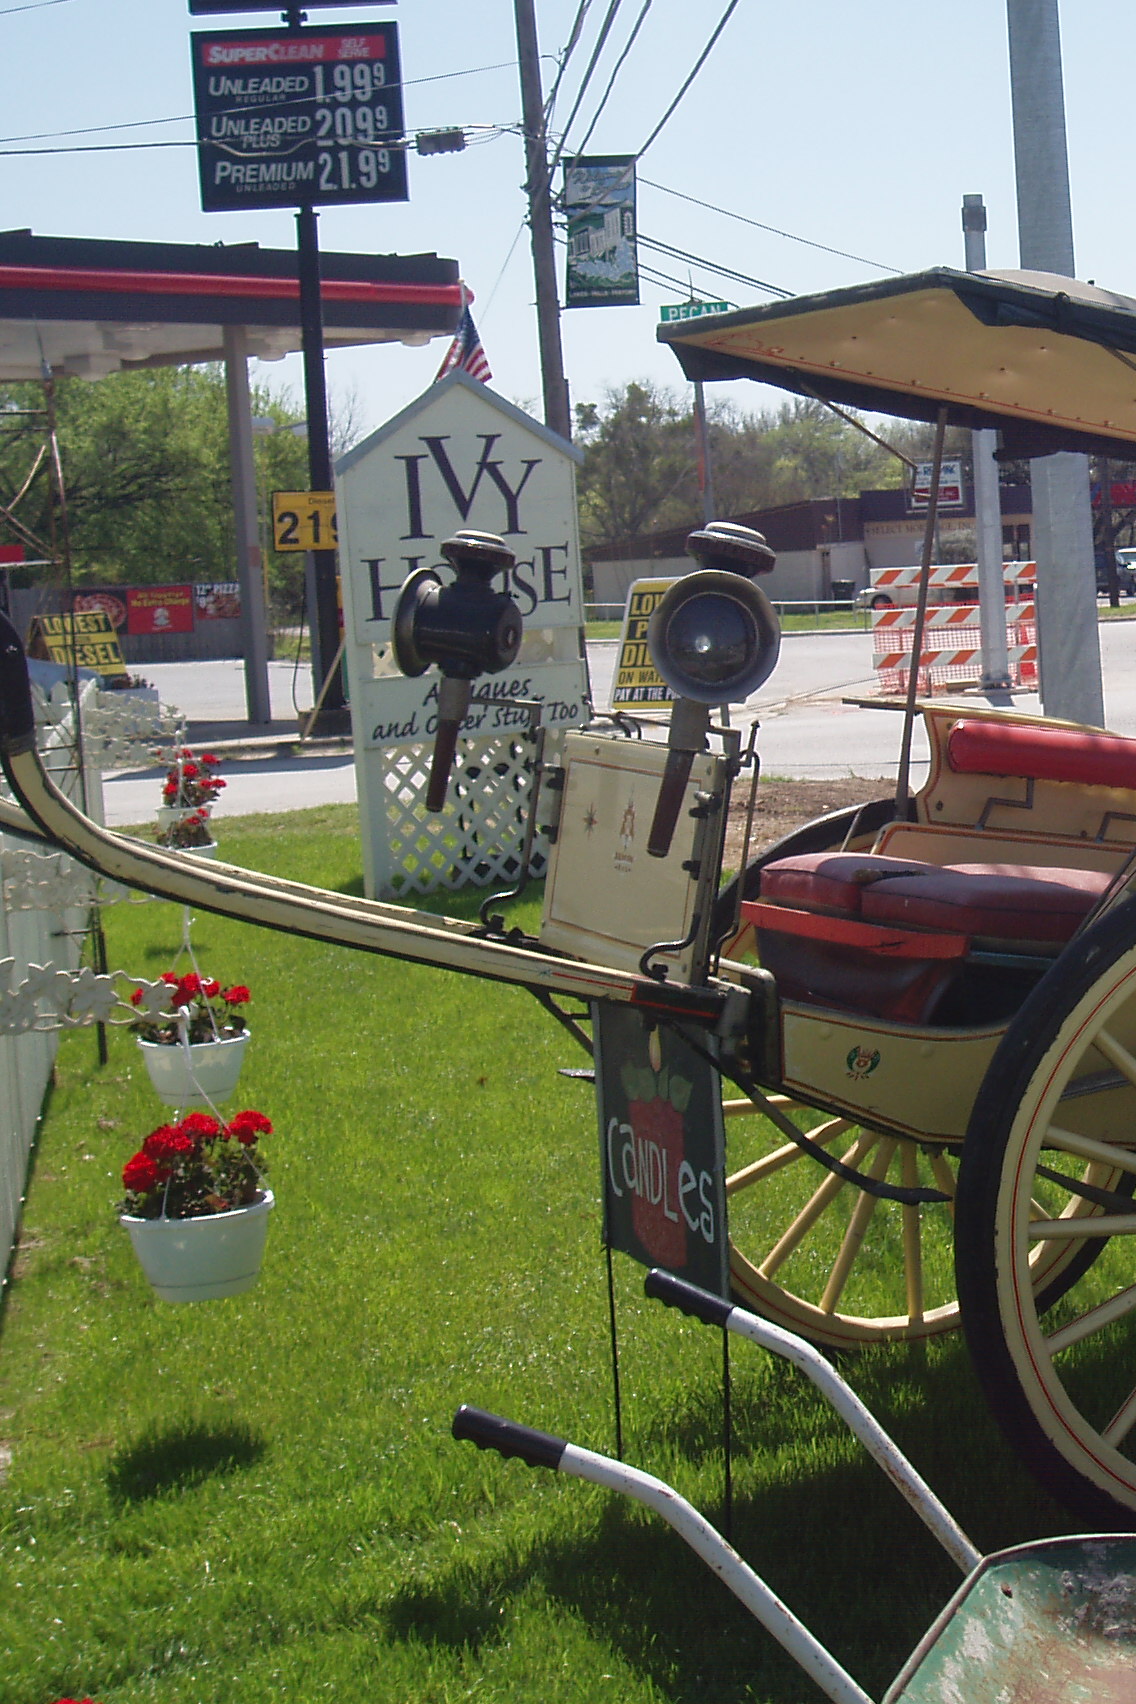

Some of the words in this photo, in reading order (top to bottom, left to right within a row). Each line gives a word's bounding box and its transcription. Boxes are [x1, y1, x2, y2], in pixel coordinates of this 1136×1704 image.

[208, 75, 310, 97] UNLEADED
[235, 92, 287, 103] REGULAR
[211, 115, 312, 137] UNLEADED
[241, 133, 281, 149] PLUS
[214, 161, 315, 186] PREMIUM
[667, 304, 722, 322] PECAN
[394, 434, 543, 540] IVY
[360, 541, 572, 623] HSE
[618, 672, 634, 685] ON
[614, 689, 634, 702] PAY
[633, 688, 646, 702] AT
[647, 687, 665, 701] THE
[372, 712, 419, 740] and
[548, 701, 579, 721] Too
